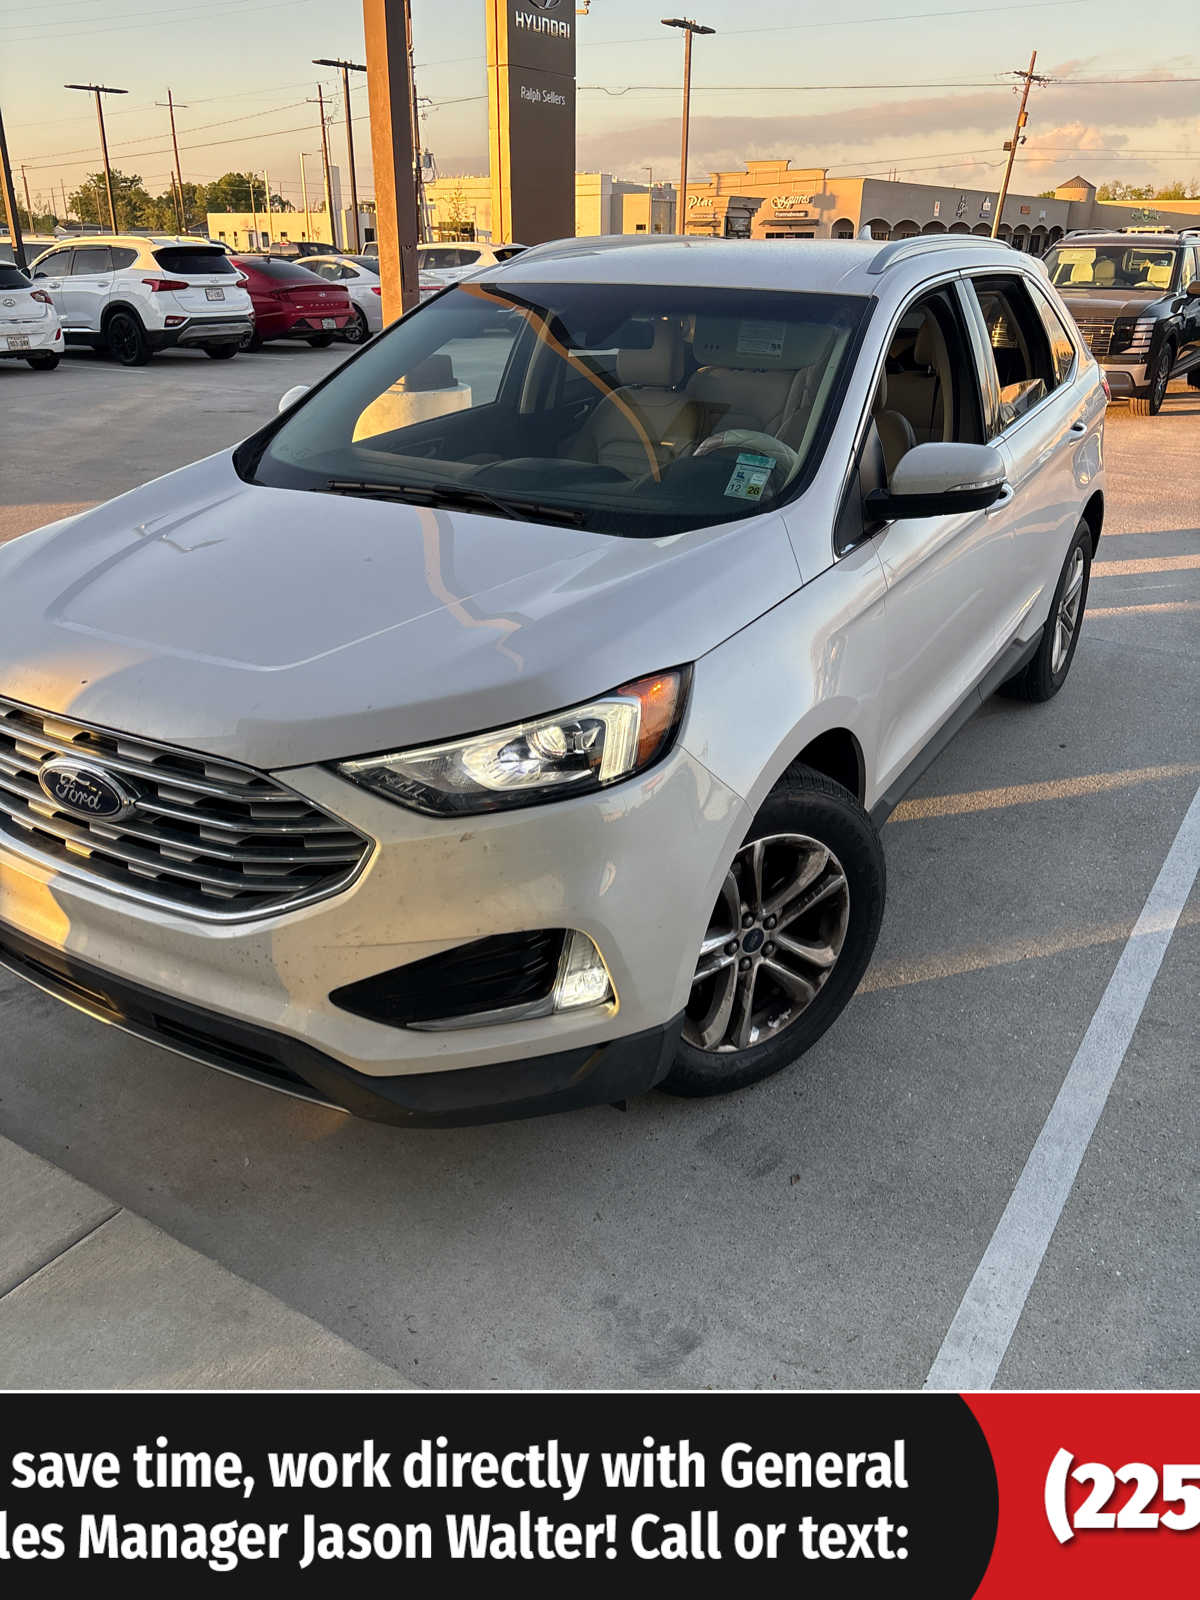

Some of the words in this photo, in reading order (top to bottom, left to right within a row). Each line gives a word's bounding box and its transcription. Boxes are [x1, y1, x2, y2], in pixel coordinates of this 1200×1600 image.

[515, 10, 570, 39] HYUNDAI
[520, 85, 541, 103] Ralph
[542, 90, 566, 105] Sellers
[747, 486, 760, 495] 26
[56, 773, 102, 810] Ford
